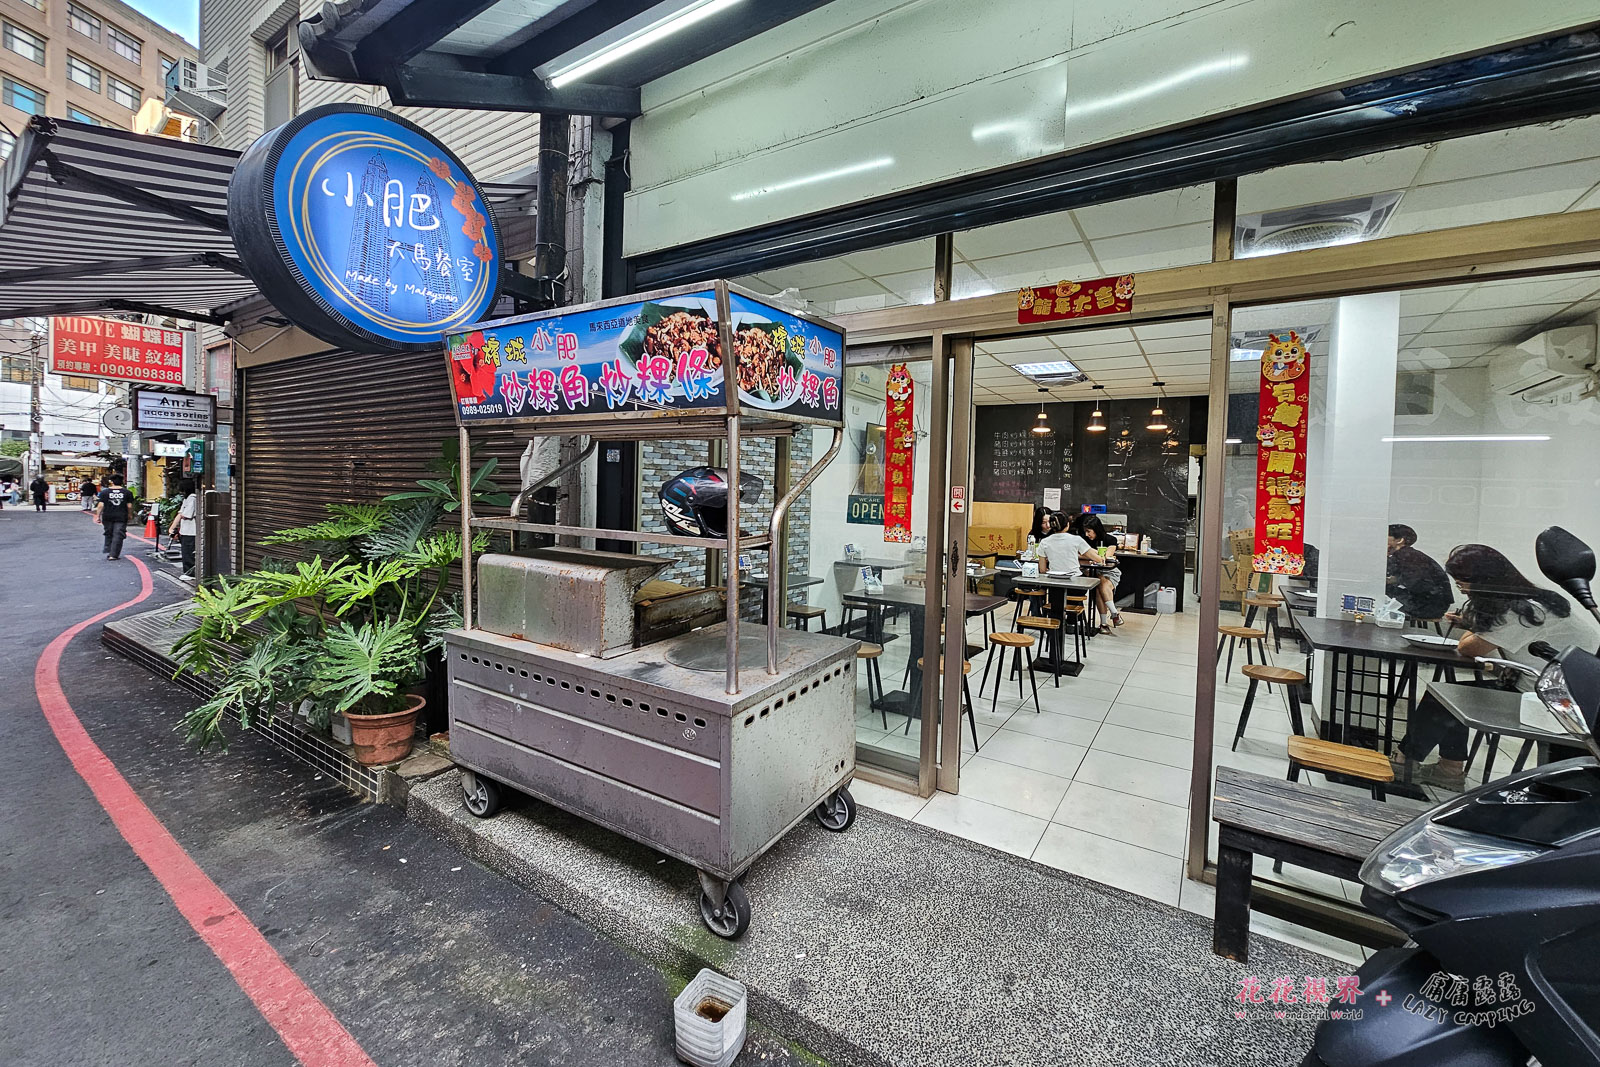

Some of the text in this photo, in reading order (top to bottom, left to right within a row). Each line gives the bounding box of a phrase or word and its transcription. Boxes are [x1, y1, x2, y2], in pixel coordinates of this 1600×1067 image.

[321, 172, 440, 231] 小肥
[345, 270, 459, 304] Made by Malaysian
[56, 317, 116, 338] MIDYE
[589, 315, 650, 333] 馬來西亞道地美食
[57, 337, 97, 357] 美甲
[103, 343, 141, 362] 美睫
[531, 327, 577, 361] 小肥
[808, 336, 836, 369] 小肥
[100, 363, 182, 382] 0903098386
[777, 365, 840, 410] 炒粿角
[852, 503, 885, 519] OPEN
